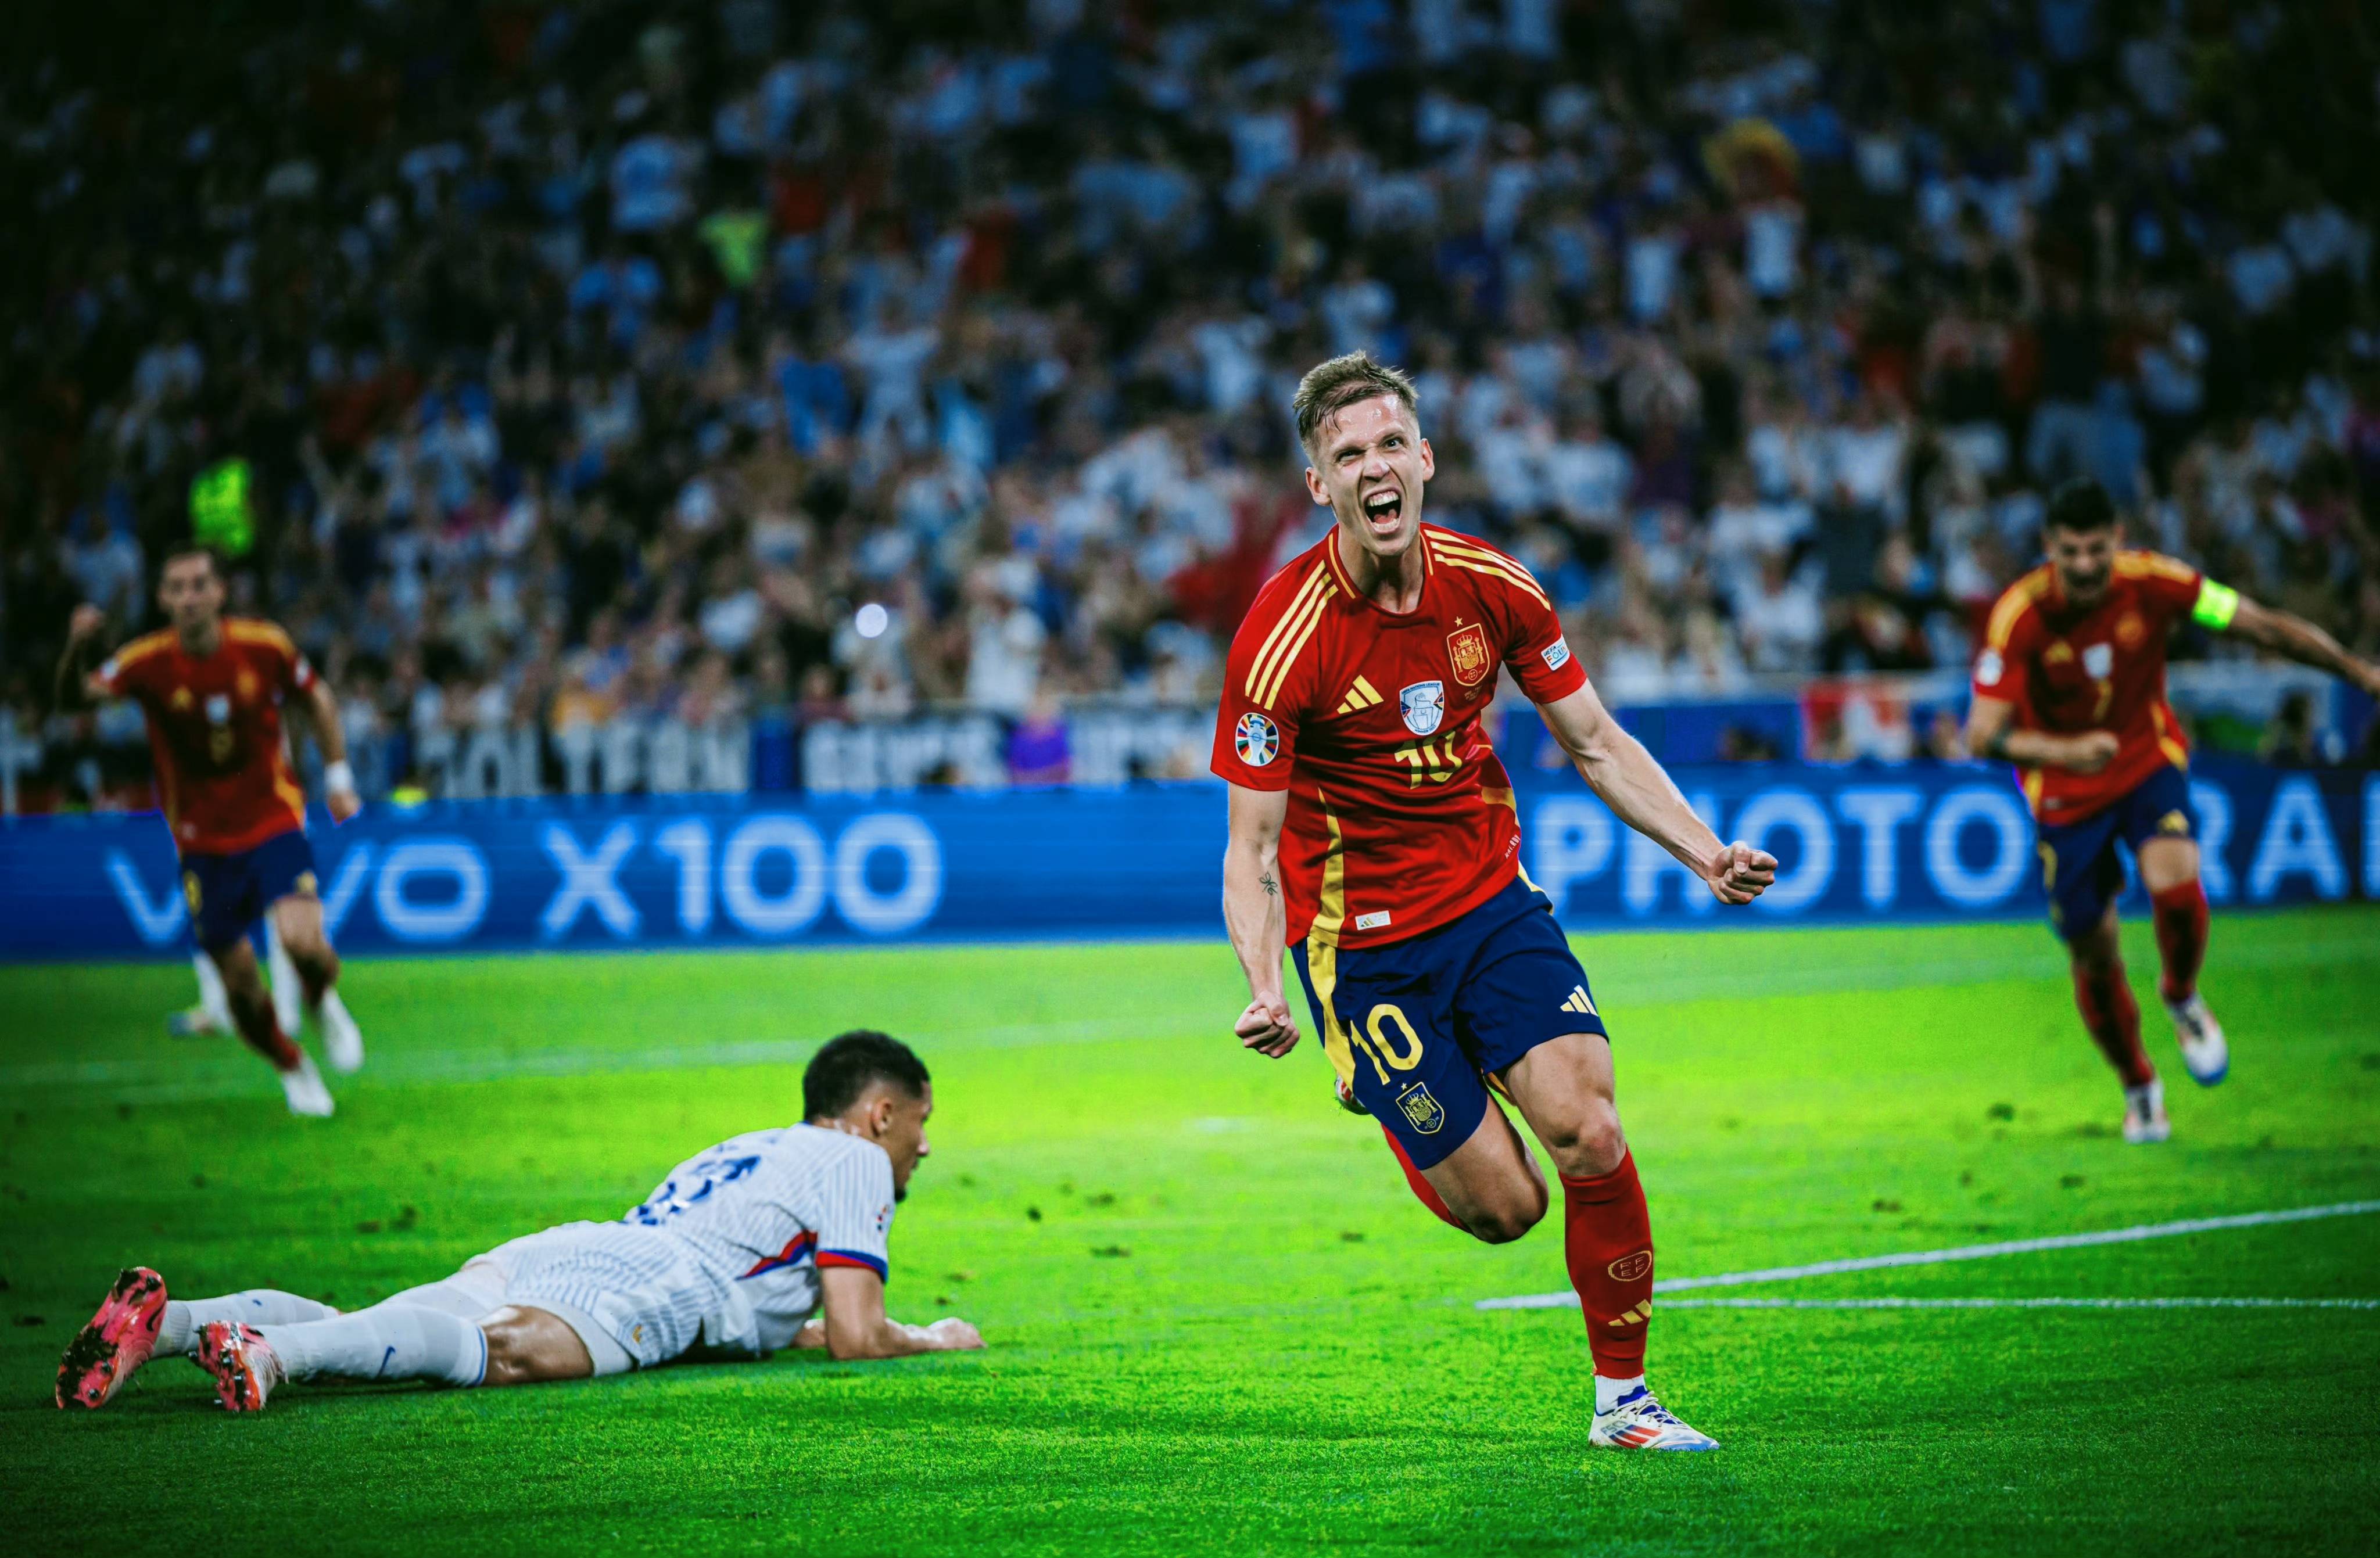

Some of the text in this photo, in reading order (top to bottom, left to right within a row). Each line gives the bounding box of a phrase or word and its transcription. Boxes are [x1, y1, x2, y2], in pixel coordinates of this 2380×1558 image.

[1394, 730, 1463, 790] 10
[106, 812, 942, 945] vvo X100
[1533, 773, 2380, 918] PHOTORA
[1350, 1003, 1424, 1086] 10
